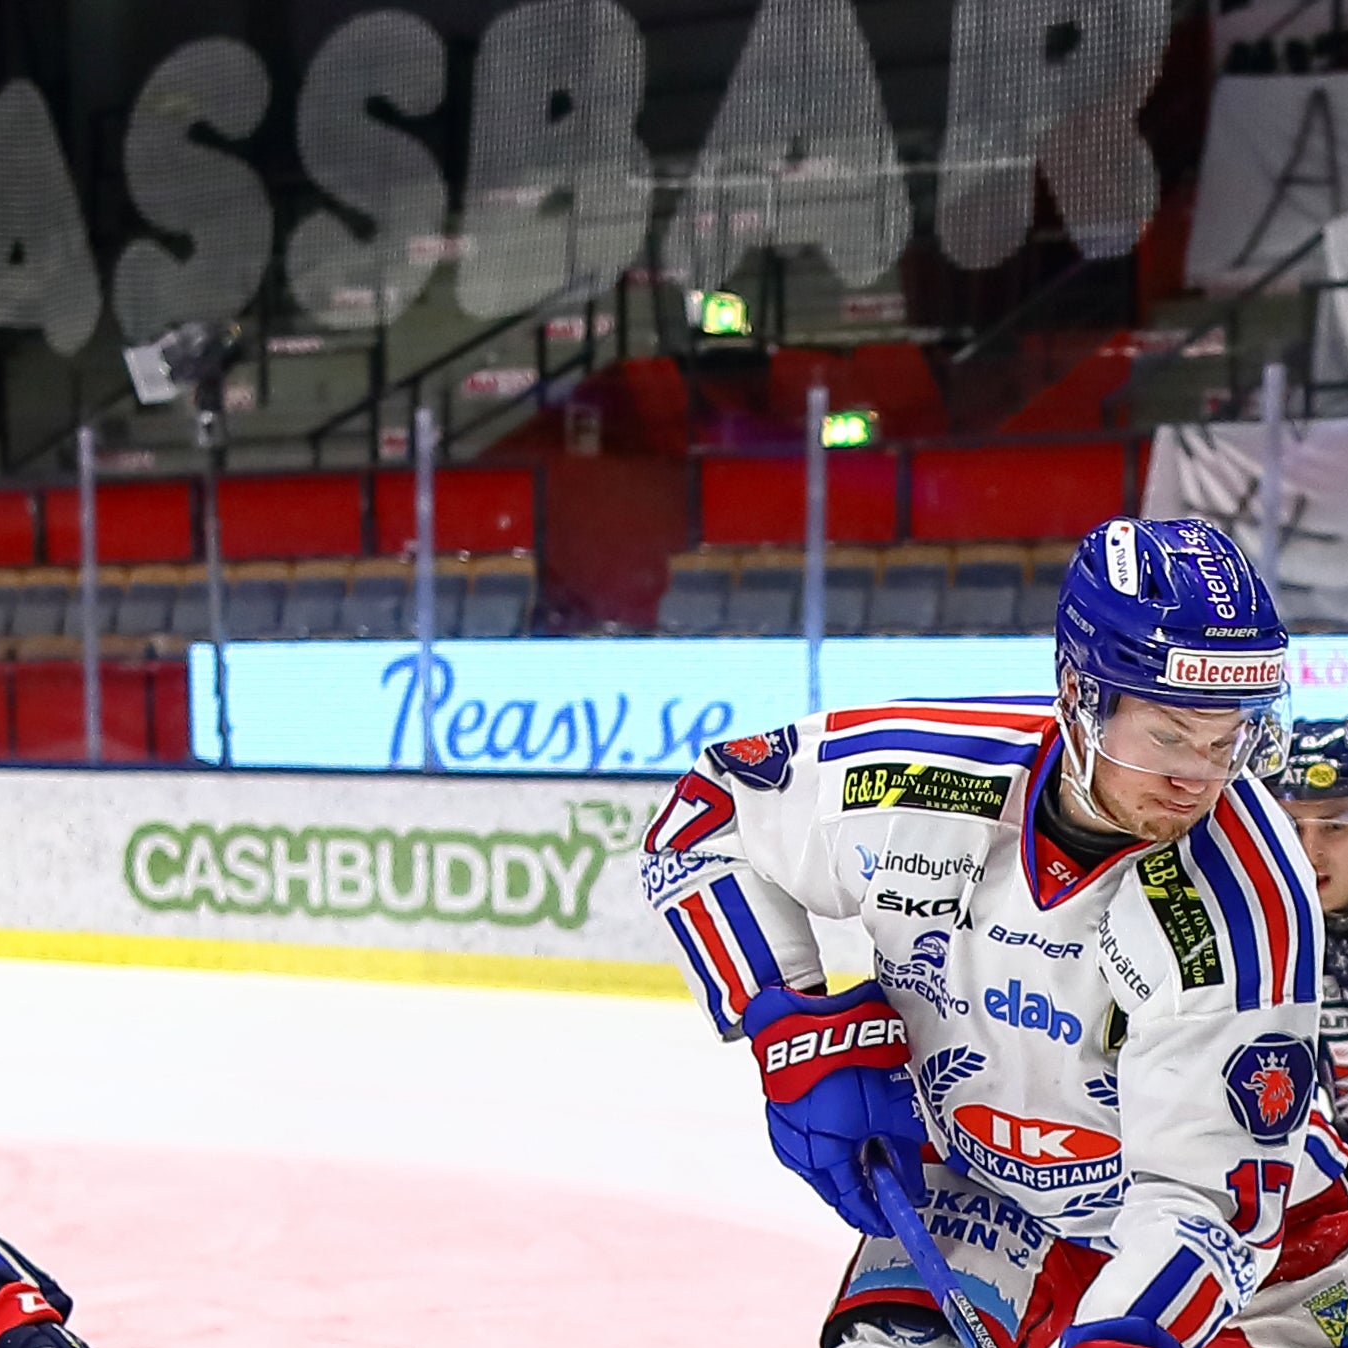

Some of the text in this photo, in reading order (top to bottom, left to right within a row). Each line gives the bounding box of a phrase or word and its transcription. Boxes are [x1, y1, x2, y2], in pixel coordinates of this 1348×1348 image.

[844, 769, 887, 804] G&B
[131, 832, 595, 918] CASHBUDDY
[956, 1131, 1119, 1190] OSKARSHAMN
[991, 1114, 1078, 1158] IK
